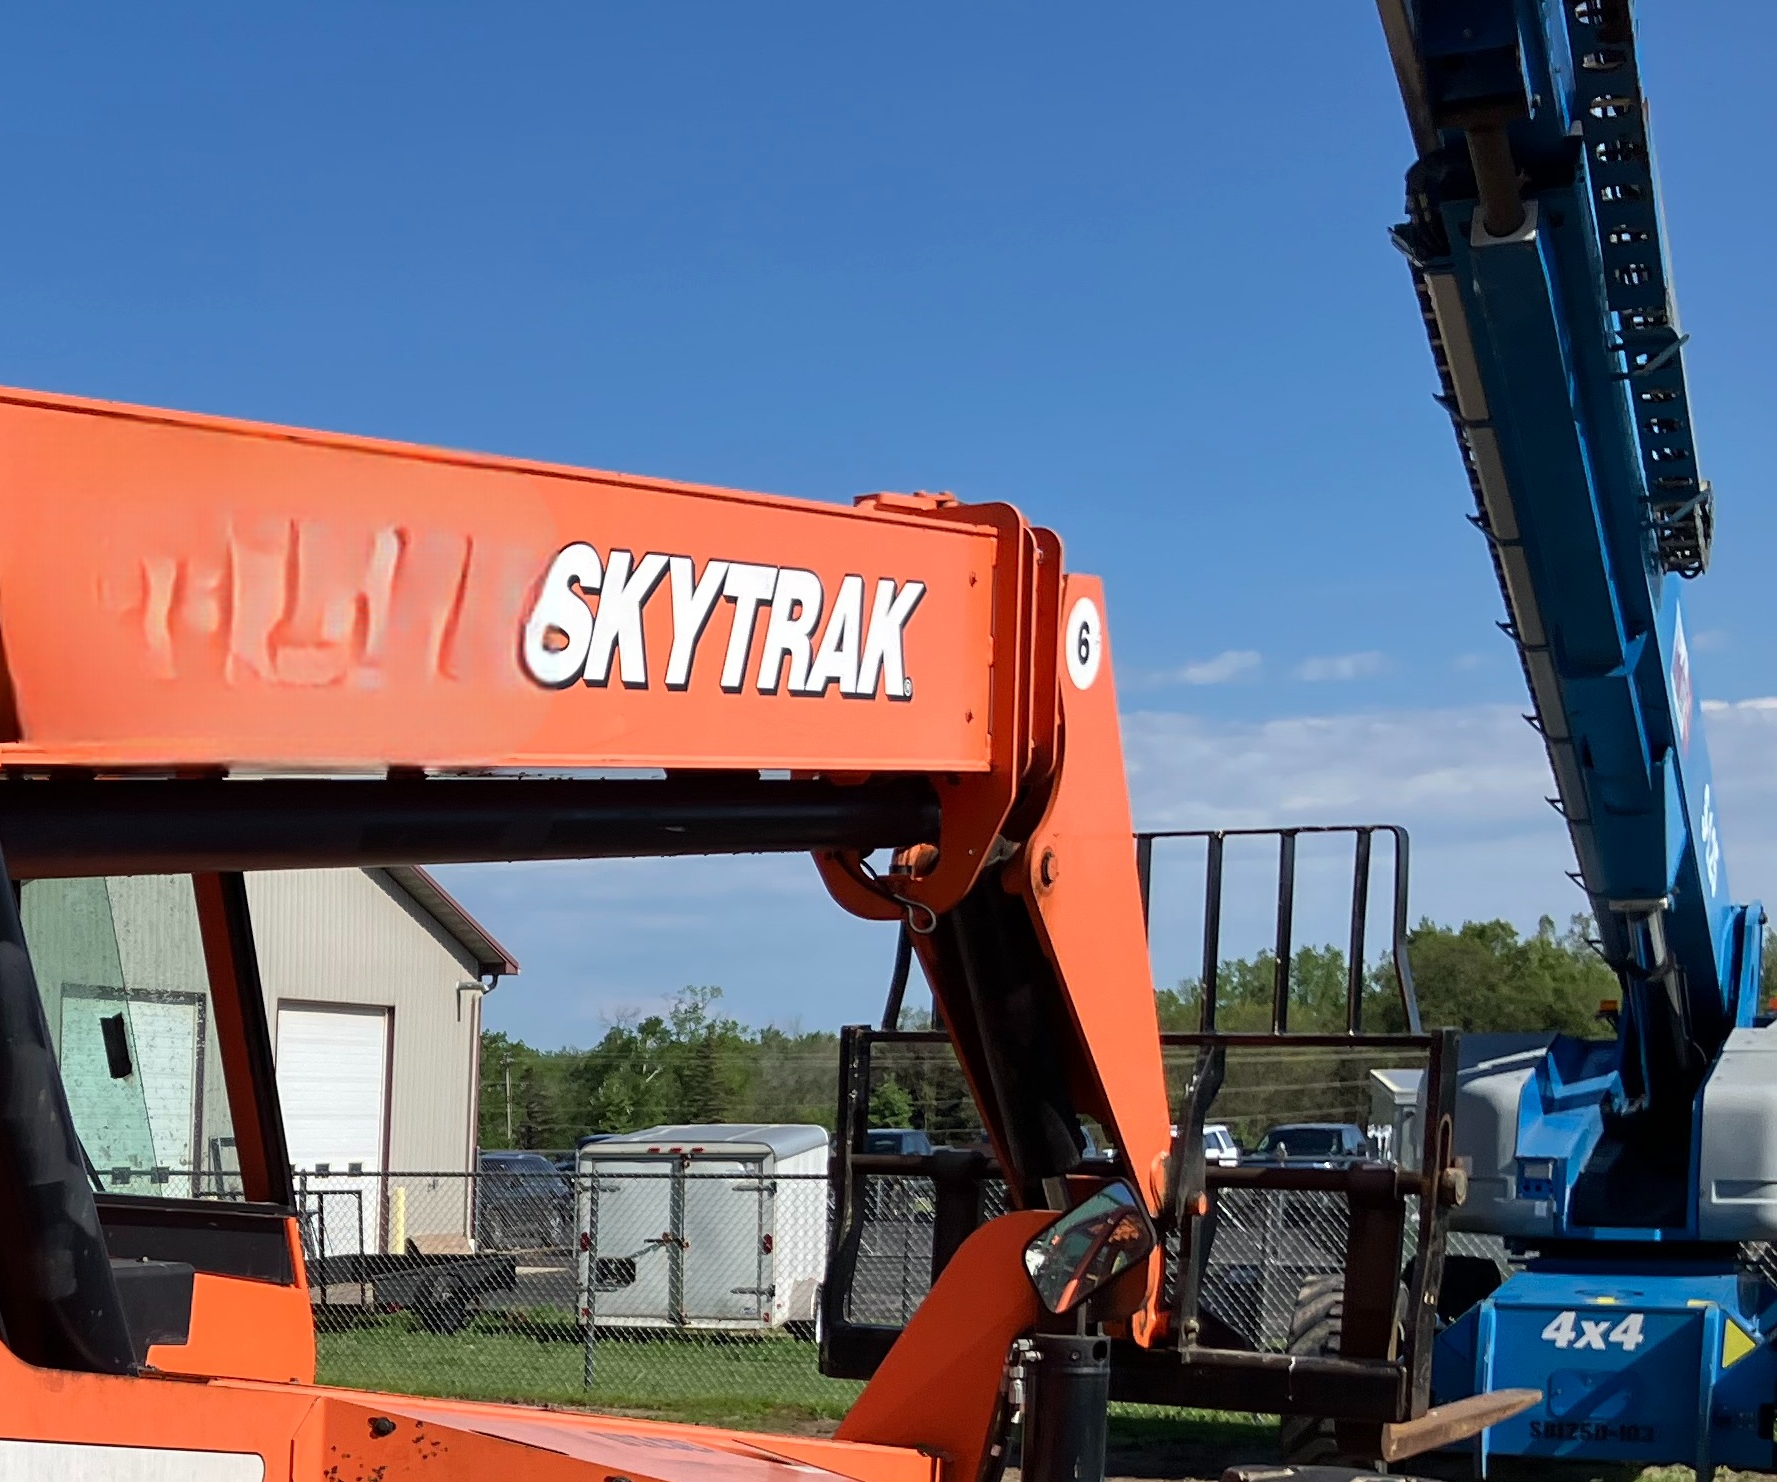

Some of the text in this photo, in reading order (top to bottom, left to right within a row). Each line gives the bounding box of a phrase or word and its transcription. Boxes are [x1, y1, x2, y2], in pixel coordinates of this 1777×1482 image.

[517, 541, 926, 702] SKYTRAK
[1078, 620, 1090, 666] 6
[1541, 1311, 1645, 1351] 4x4
